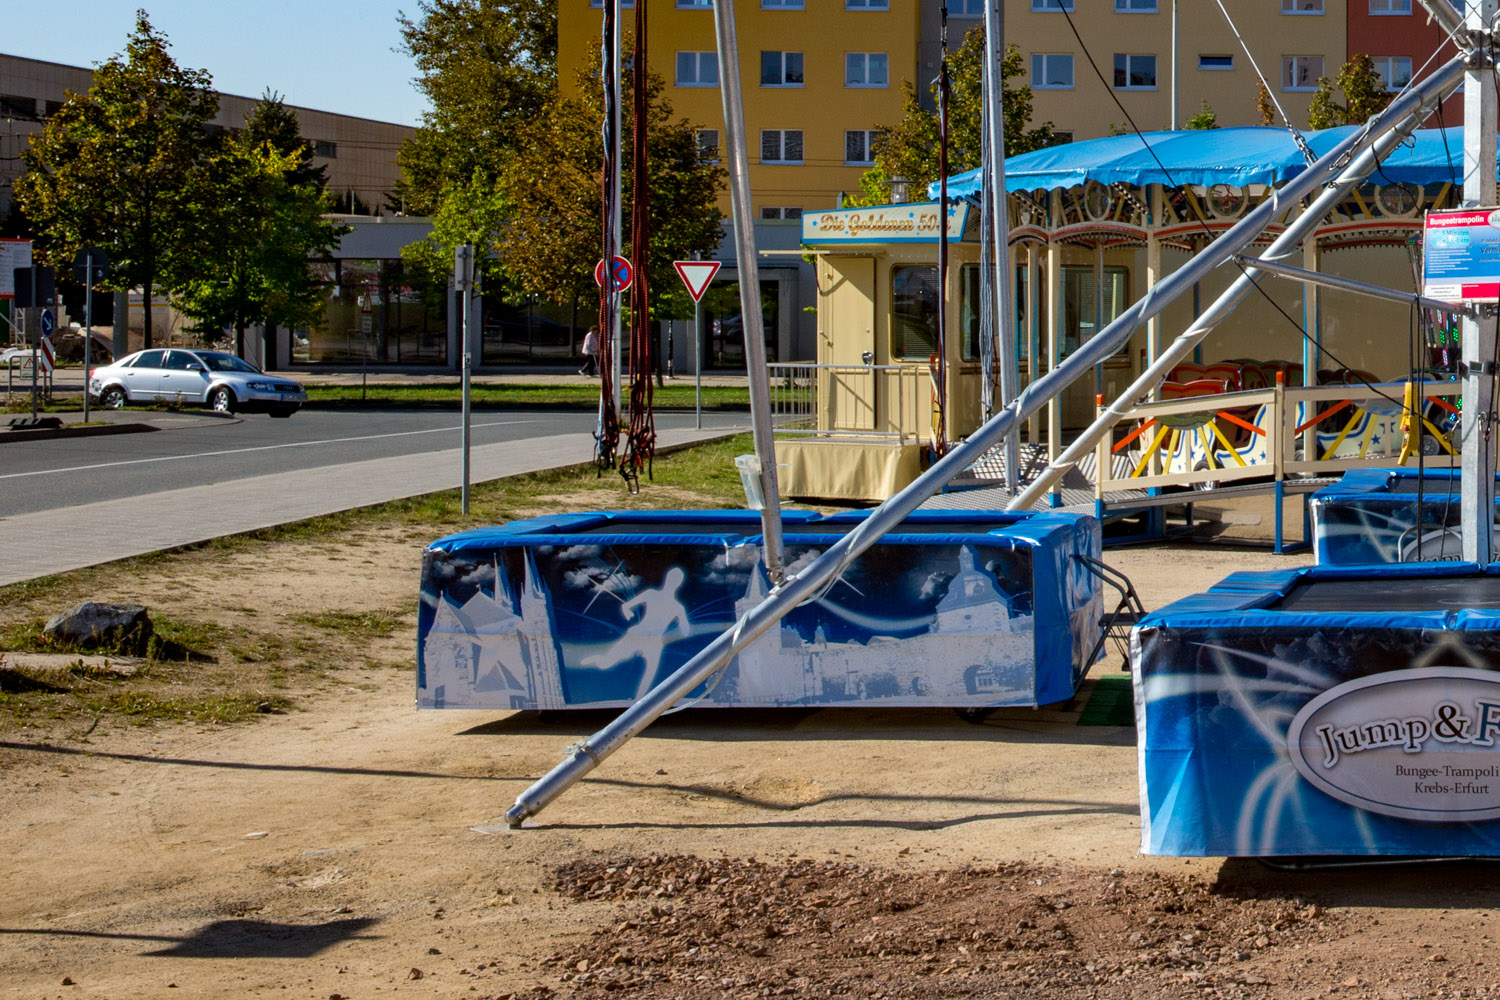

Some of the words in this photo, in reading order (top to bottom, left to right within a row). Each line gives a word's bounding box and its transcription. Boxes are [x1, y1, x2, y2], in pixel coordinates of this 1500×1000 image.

[819, 214, 845, 232] Die
[848, 213, 915, 237] Goldenen
[1430, 216, 1484, 226] Bungeetrampolin
[1414, 781, 1490, 795] Krebs-Erfurt
